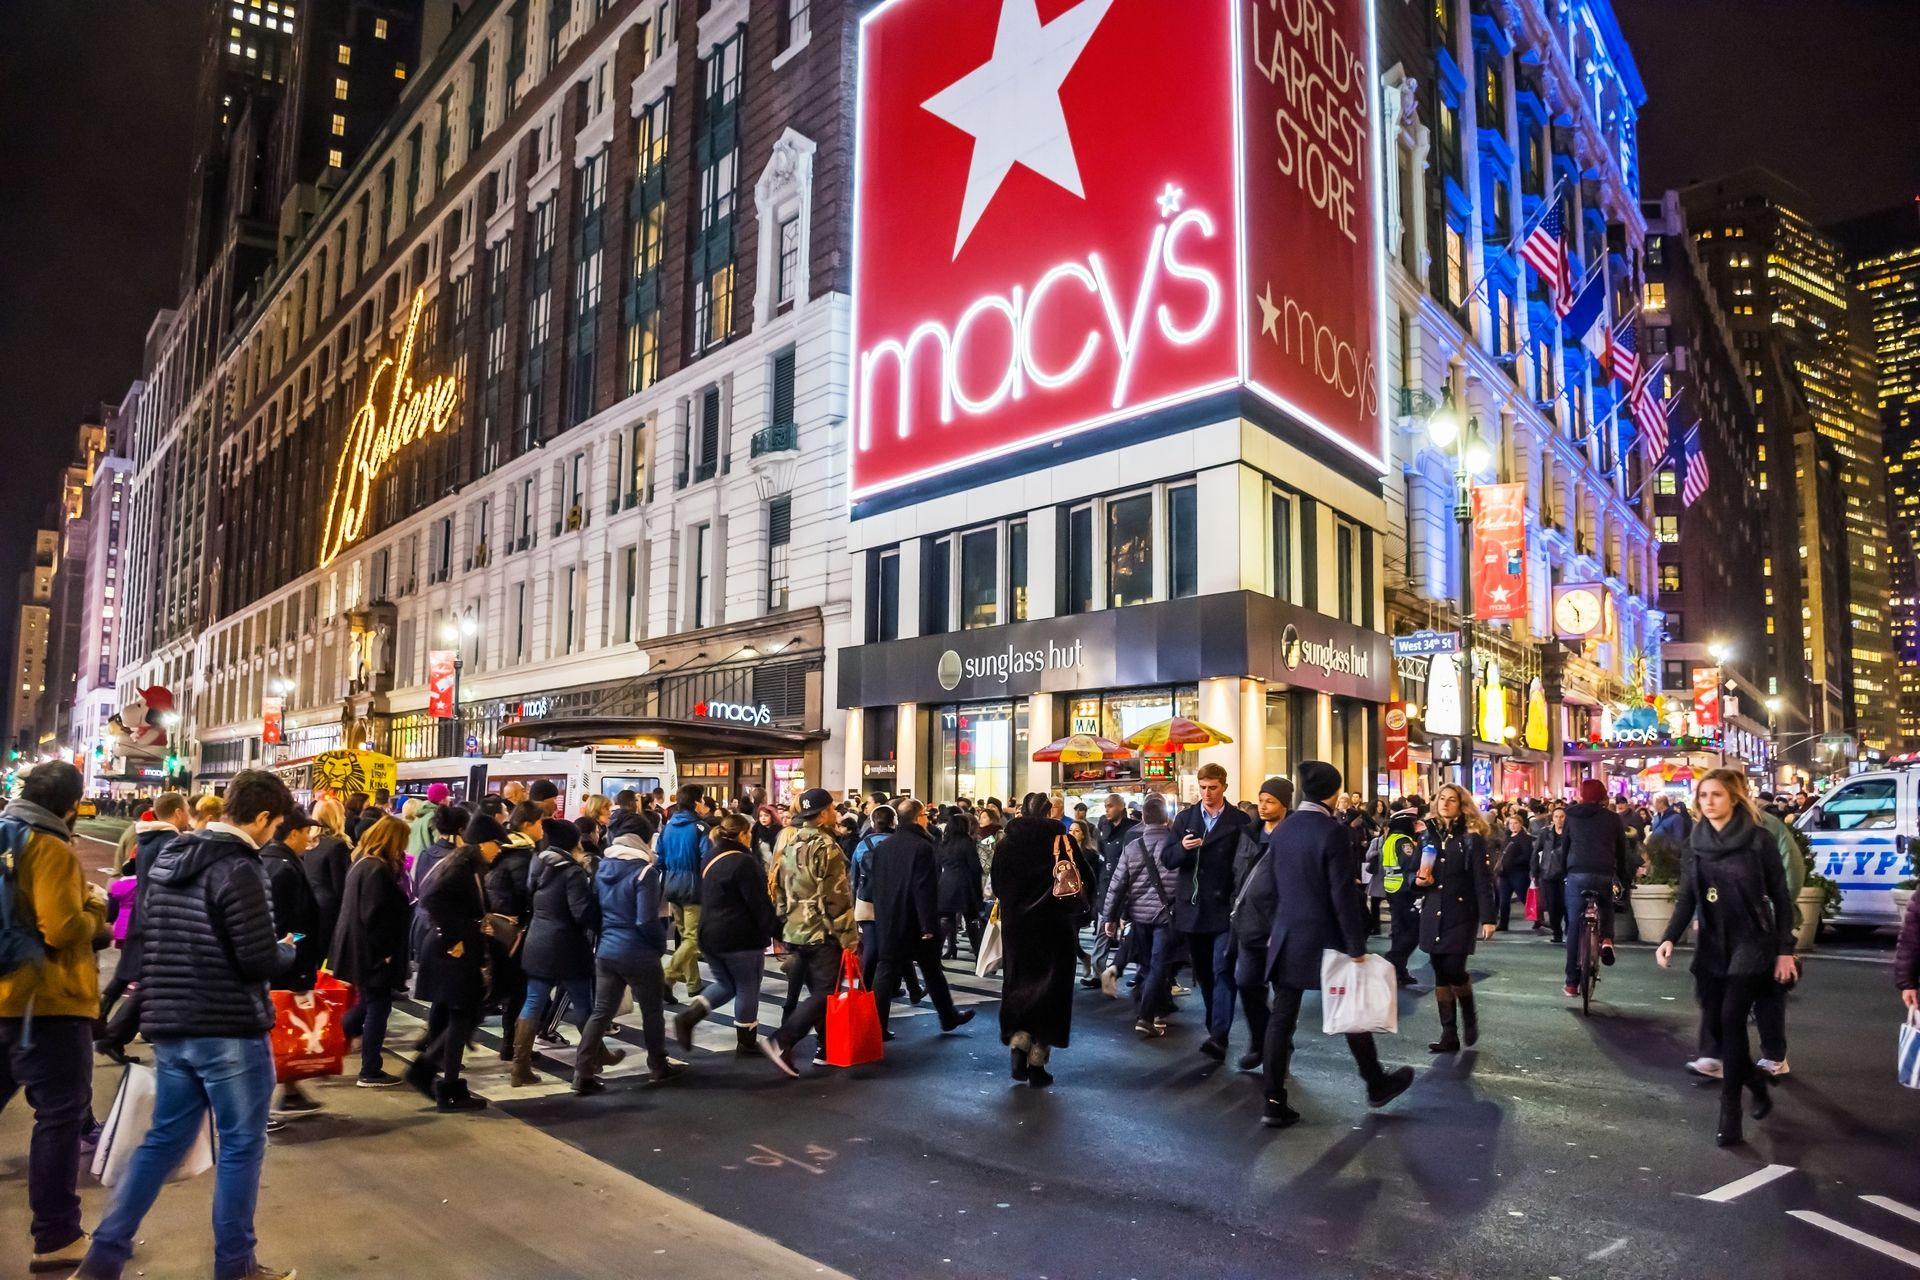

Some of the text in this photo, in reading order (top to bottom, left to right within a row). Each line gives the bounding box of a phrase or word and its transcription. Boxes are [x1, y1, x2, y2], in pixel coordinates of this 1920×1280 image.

[1253, 2, 1367, 181] LARGEST
[1270, 0, 1367, 117] ORLD'S
[1276, 108, 1357, 244] STORE
[1284, 296, 1378, 421] macy's
[320, 289, 458, 569] Believe
[965, 639, 1082, 683] sunglass hut
[1302, 639, 1368, 678] sunglass hut
[1399, 638, 1451, 651] West 34th St
[708, 702, 771, 726] macy's
